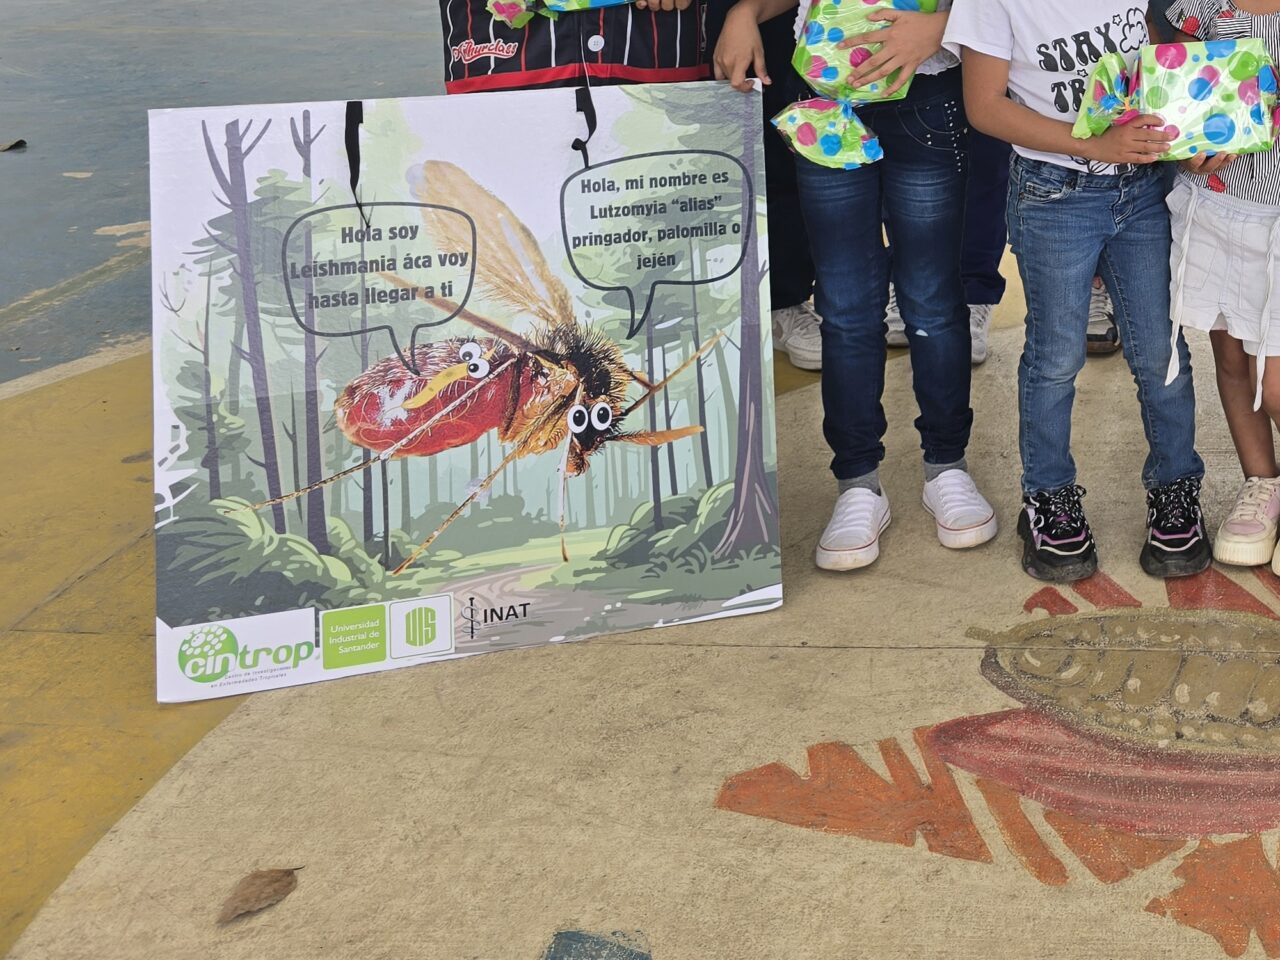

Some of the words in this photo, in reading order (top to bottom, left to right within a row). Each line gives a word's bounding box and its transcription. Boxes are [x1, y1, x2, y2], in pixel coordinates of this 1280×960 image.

[1036, 22, 1118, 72] STAY
[581, 178, 620, 193] Hola,
[625, 175, 644, 190] mi
[649, 172, 707, 189] nombre
[712, 171, 729, 183] es
[590, 200, 667, 220] Lutzomyia
[341, 226, 382, 243] Hola
[388, 225, 419, 241] soy
[572, 229, 652, 249] pringador,
[657, 222, 727, 241] palomilla
[732, 222, 741, 234] o
[290, 255, 397, 279] Leishmania
[403, 253, 432, 270] áca
[438, 252, 468, 268] voy
[636, 252, 676, 270] jején
[308, 290, 359, 309] hasta
[365, 286, 419, 305] llegar
[424, 286, 435, 299] a
[440, 281, 453, 297] ti
[483, 603, 530, 623] INAT
[330, 619, 380, 633] Universidad
[329, 631, 367, 645] Industrial
[369, 630, 380, 638] de
[338, 641, 380, 654] Santander
